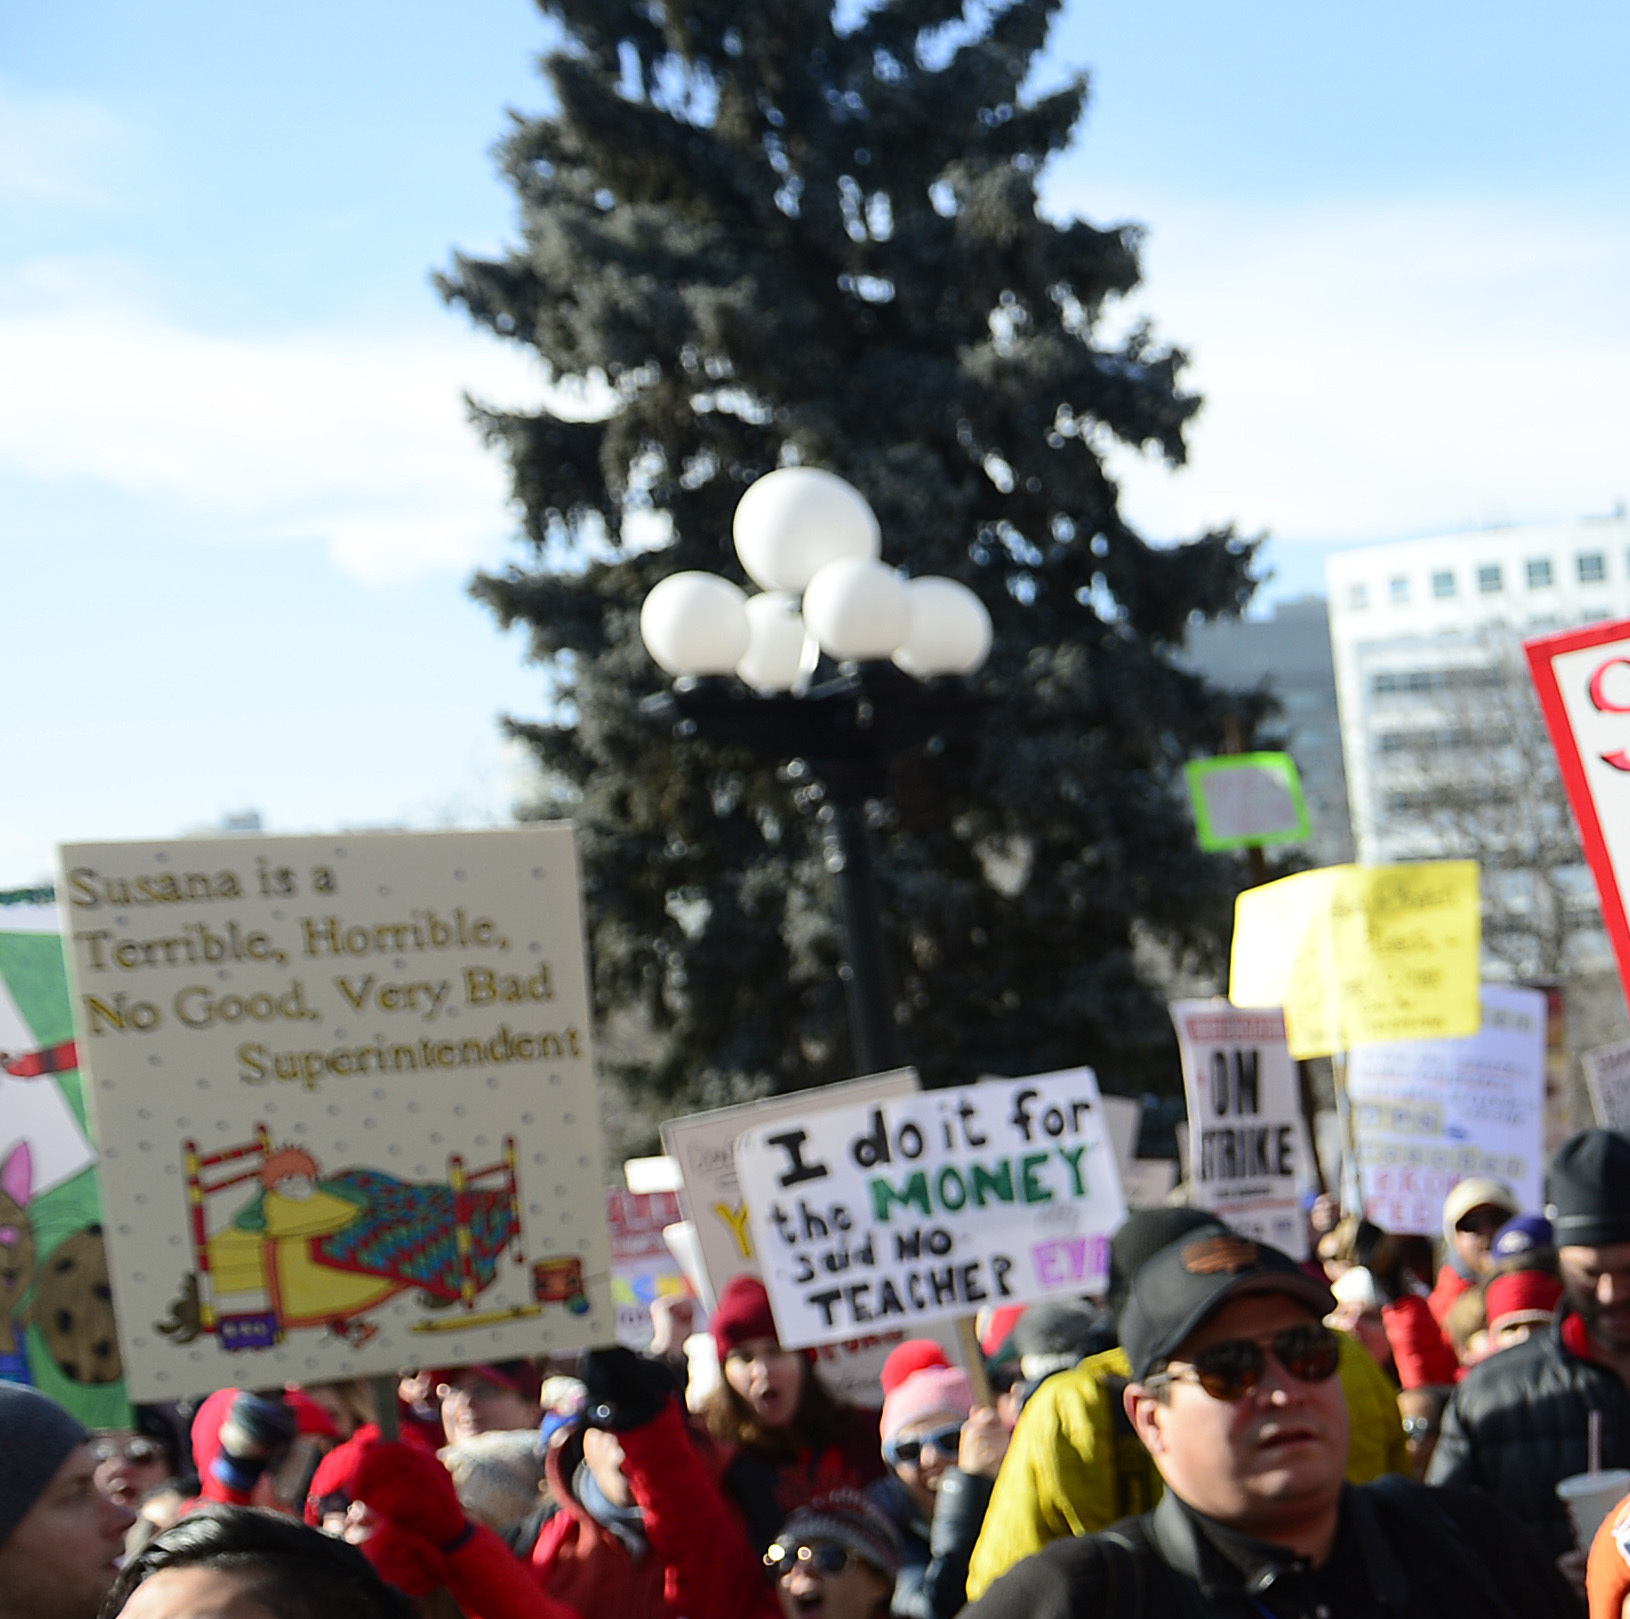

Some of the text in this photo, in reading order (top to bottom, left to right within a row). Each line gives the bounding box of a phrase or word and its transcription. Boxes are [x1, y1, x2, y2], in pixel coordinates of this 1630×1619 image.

[67, 858, 341, 909] Susana is a
[76, 907, 511, 976] Terrible, Horrible,
[83, 962, 556, 1036] No Good, Very Bad
[239, 1024, 584, 1090] Superintendent
[1211, 1050, 1260, 1117] ON
[768, 1130, 828, 1188] I
[854, 1106, 923, 1168] do
[940, 1096, 987, 1147] it
[1011, 1090, 1091, 1141] for
[1200, 1126, 1293, 1181] STRIKE
[770, 1203, 852, 1246] the
[871, 1145, 1086, 1222] MONEY
[797, 1227, 953, 1284] said NO
[808, 1256, 1012, 1326] TEACHER
